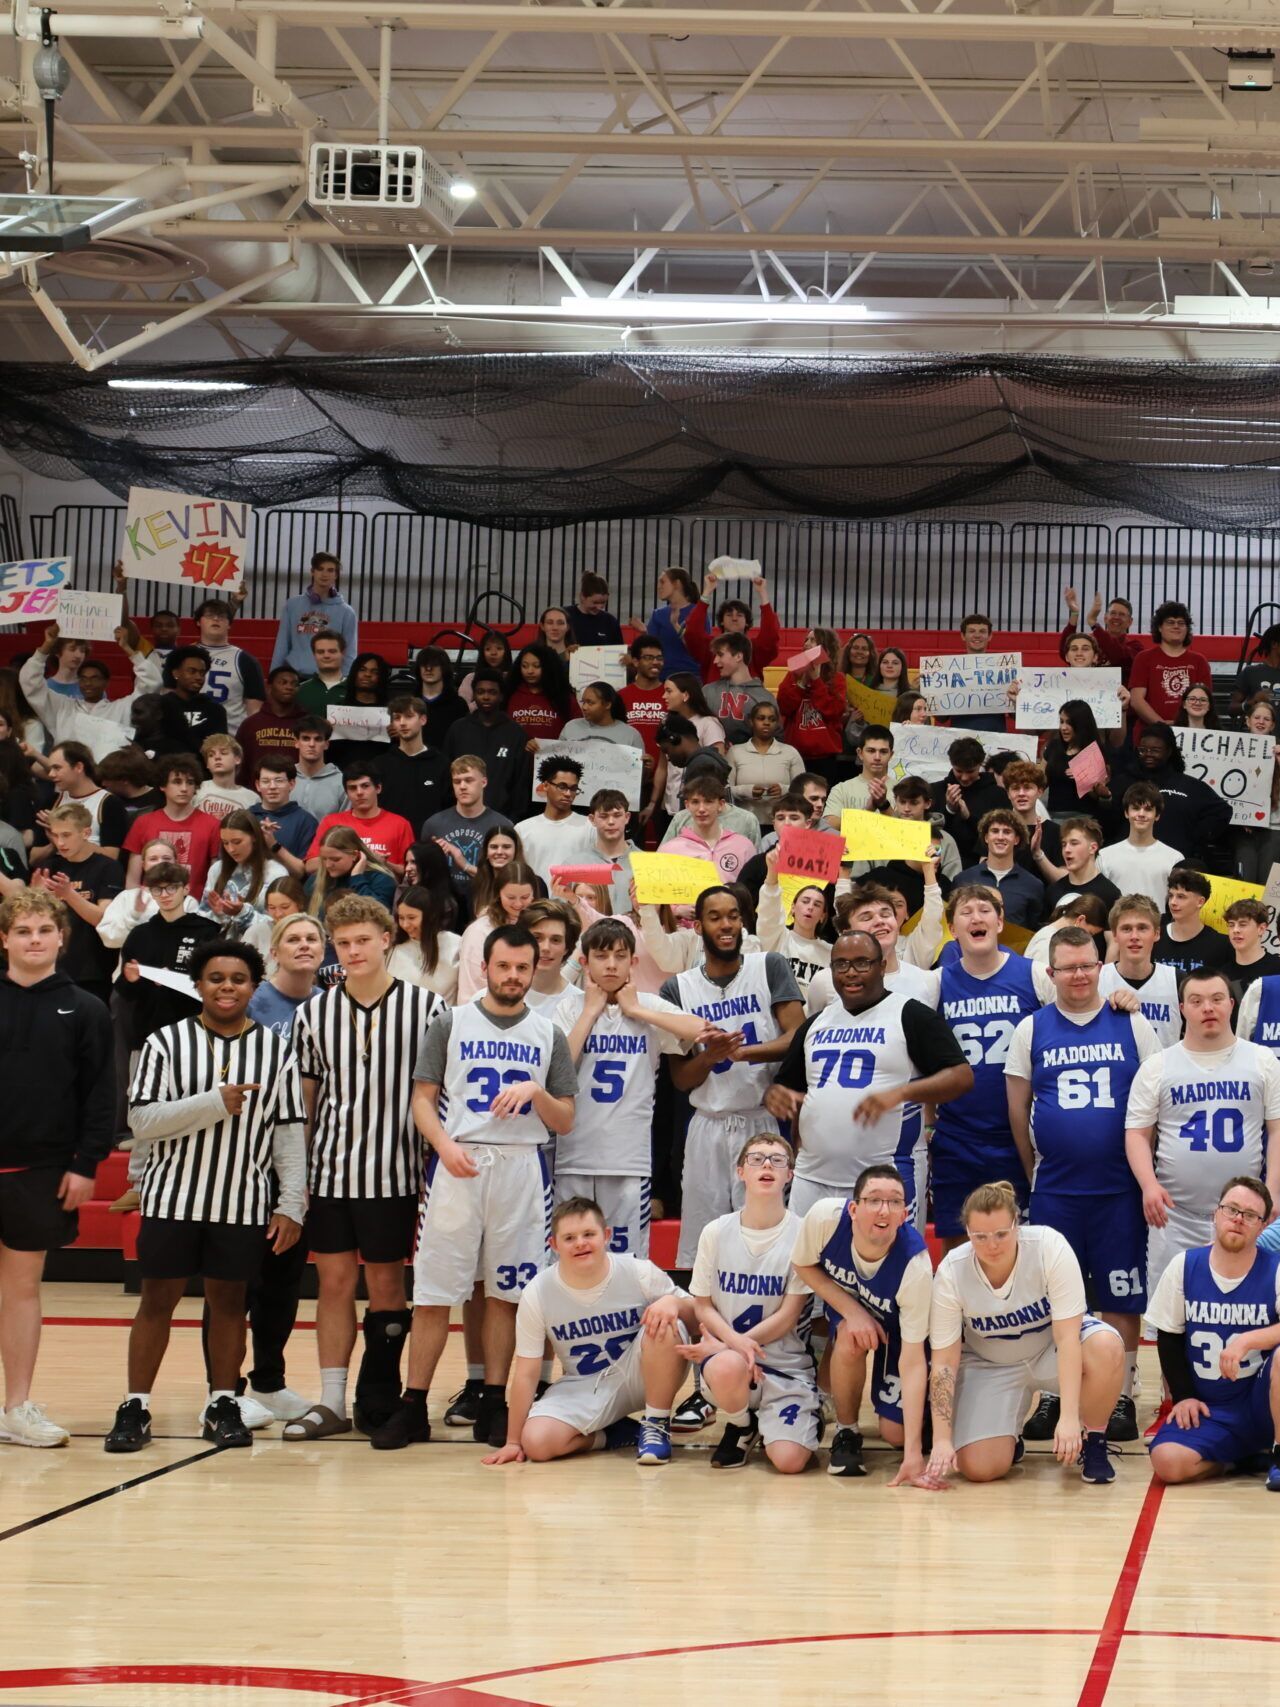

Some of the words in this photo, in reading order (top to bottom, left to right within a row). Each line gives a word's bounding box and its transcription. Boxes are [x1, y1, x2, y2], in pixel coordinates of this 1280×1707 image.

[125, 502, 247, 560] KEVIN
[192, 550, 230, 580] 47
[60, 602, 112, 617] MICHAEL
[948, 657, 996, 672] ALEC
[921, 671, 948, 688] #39
[512, 709, 557, 718] RONCALLI
[515, 716, 553, 725] CATHOLIC
[632, 702, 662, 711] RAPID
[719, 692, 749, 721] N
[786, 854, 830, 875] GOAT!
[693, 994, 762, 1023] MADONNA
[944, 995, 1021, 1021] MADONNA
[811, 1027, 886, 1046] MADONNA
[951, 1020, 1010, 1066] 62
[460, 1041, 541, 1067] MADONNA
[1043, 1044, 1125, 1068] MADONNA
[591, 1061, 627, 1104] 5
[811, 1049, 876, 1089] 70
[1056, 1067, 1116, 1110] 61
[1171, 1081, 1251, 1105] MADONNA
[1178, 1108, 1244, 1153] 40
[609, 1227, 629, 1254] 5
[496, 1262, 538, 1291] 33
[1108, 1269, 1144, 1297] 61
[551, 1308, 641, 1342] MADONNA
[732, 1305, 764, 1333] 4
[970, 1296, 1052, 1331] MADONNA
[1185, 1299, 1271, 1327] MADONNA
[878, 1374, 903, 1409] 3
[778, 1403, 800, 1426] 4
